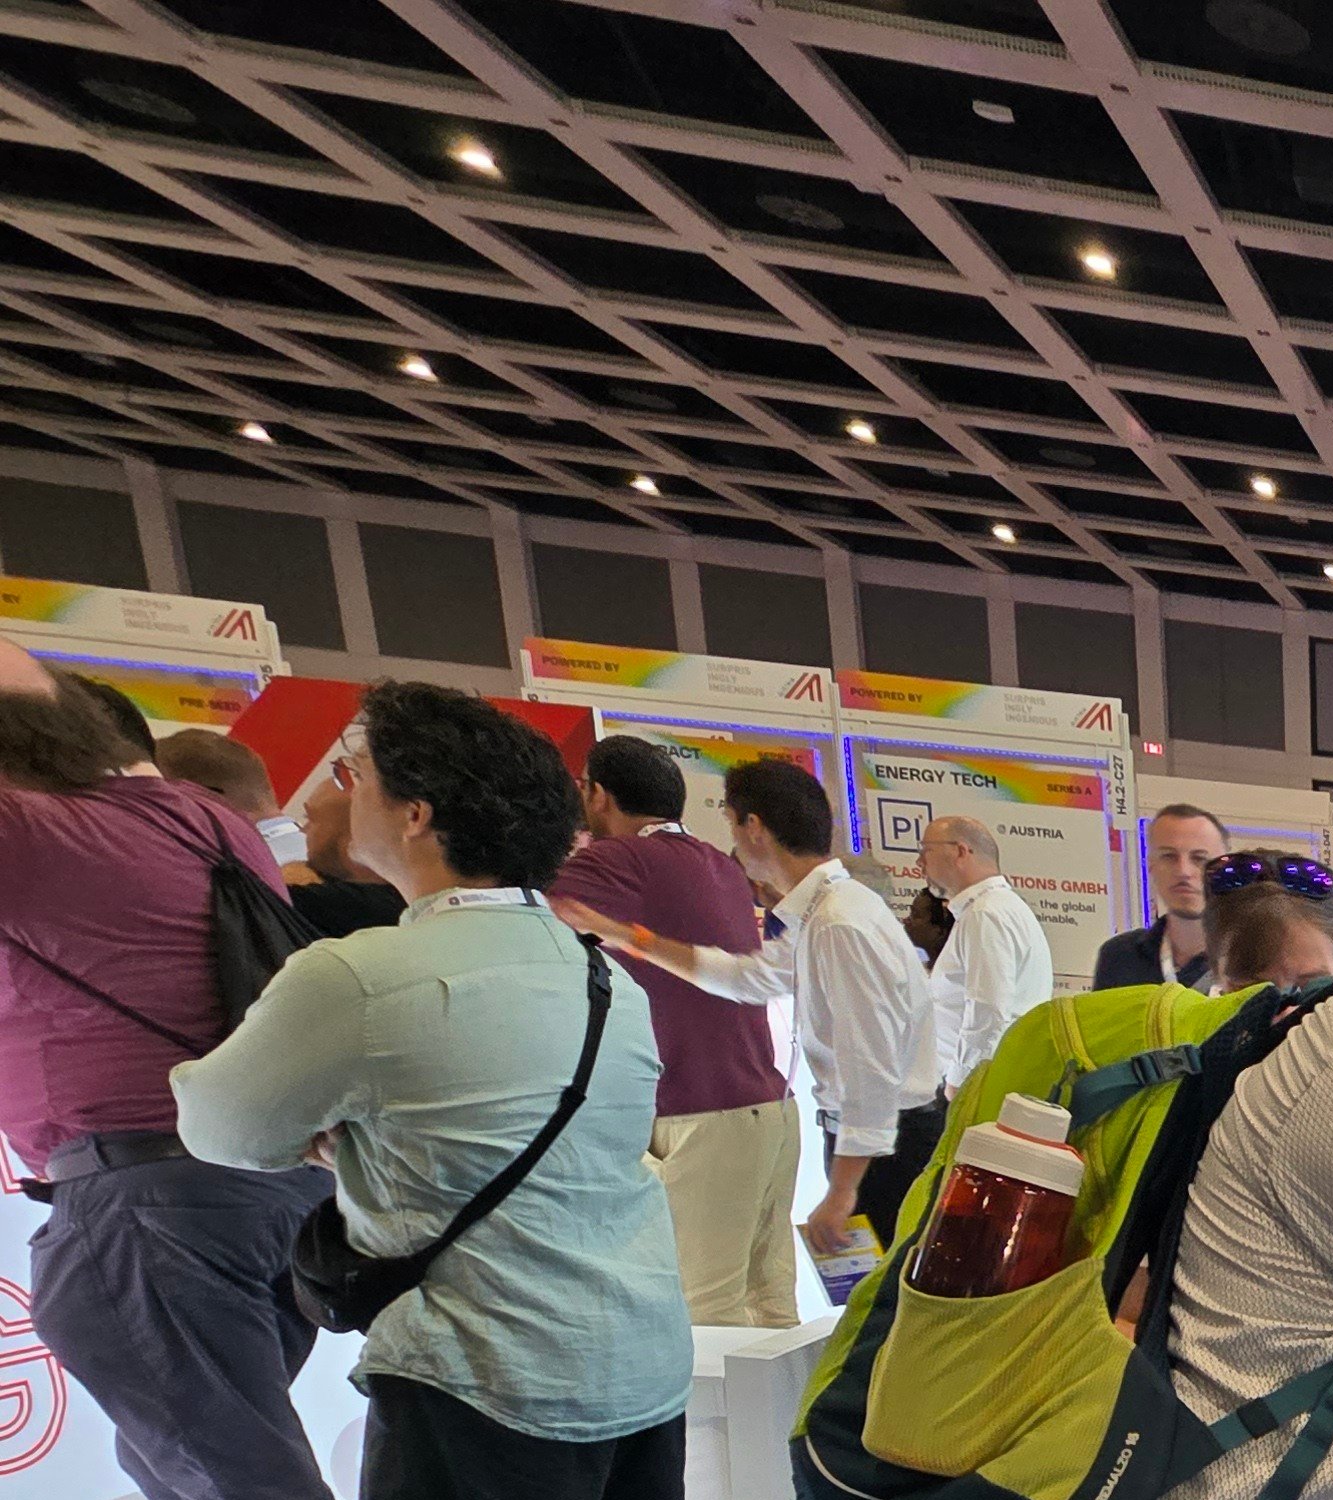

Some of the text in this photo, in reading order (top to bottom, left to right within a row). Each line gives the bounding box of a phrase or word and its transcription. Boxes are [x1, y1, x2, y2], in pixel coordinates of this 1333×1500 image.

[542, 655, 621, 673] POWERED BY
[850, 687, 923, 704] POWERED BY
[875, 764, 998, 790] ENERGY TECH
[1046, 783, 1093, 796] SERIES A
[1113, 755, 1127, 816] H4.2-C27
[1009, 825, 1065, 841] AUSTRIA
[1322, 827, 1332, 867] 4.2-D47
[884, 865, 924, 880] PLAS
[1060, 880, 1108, 896] GMBH
[1040, 899, 1096, 914] the global
